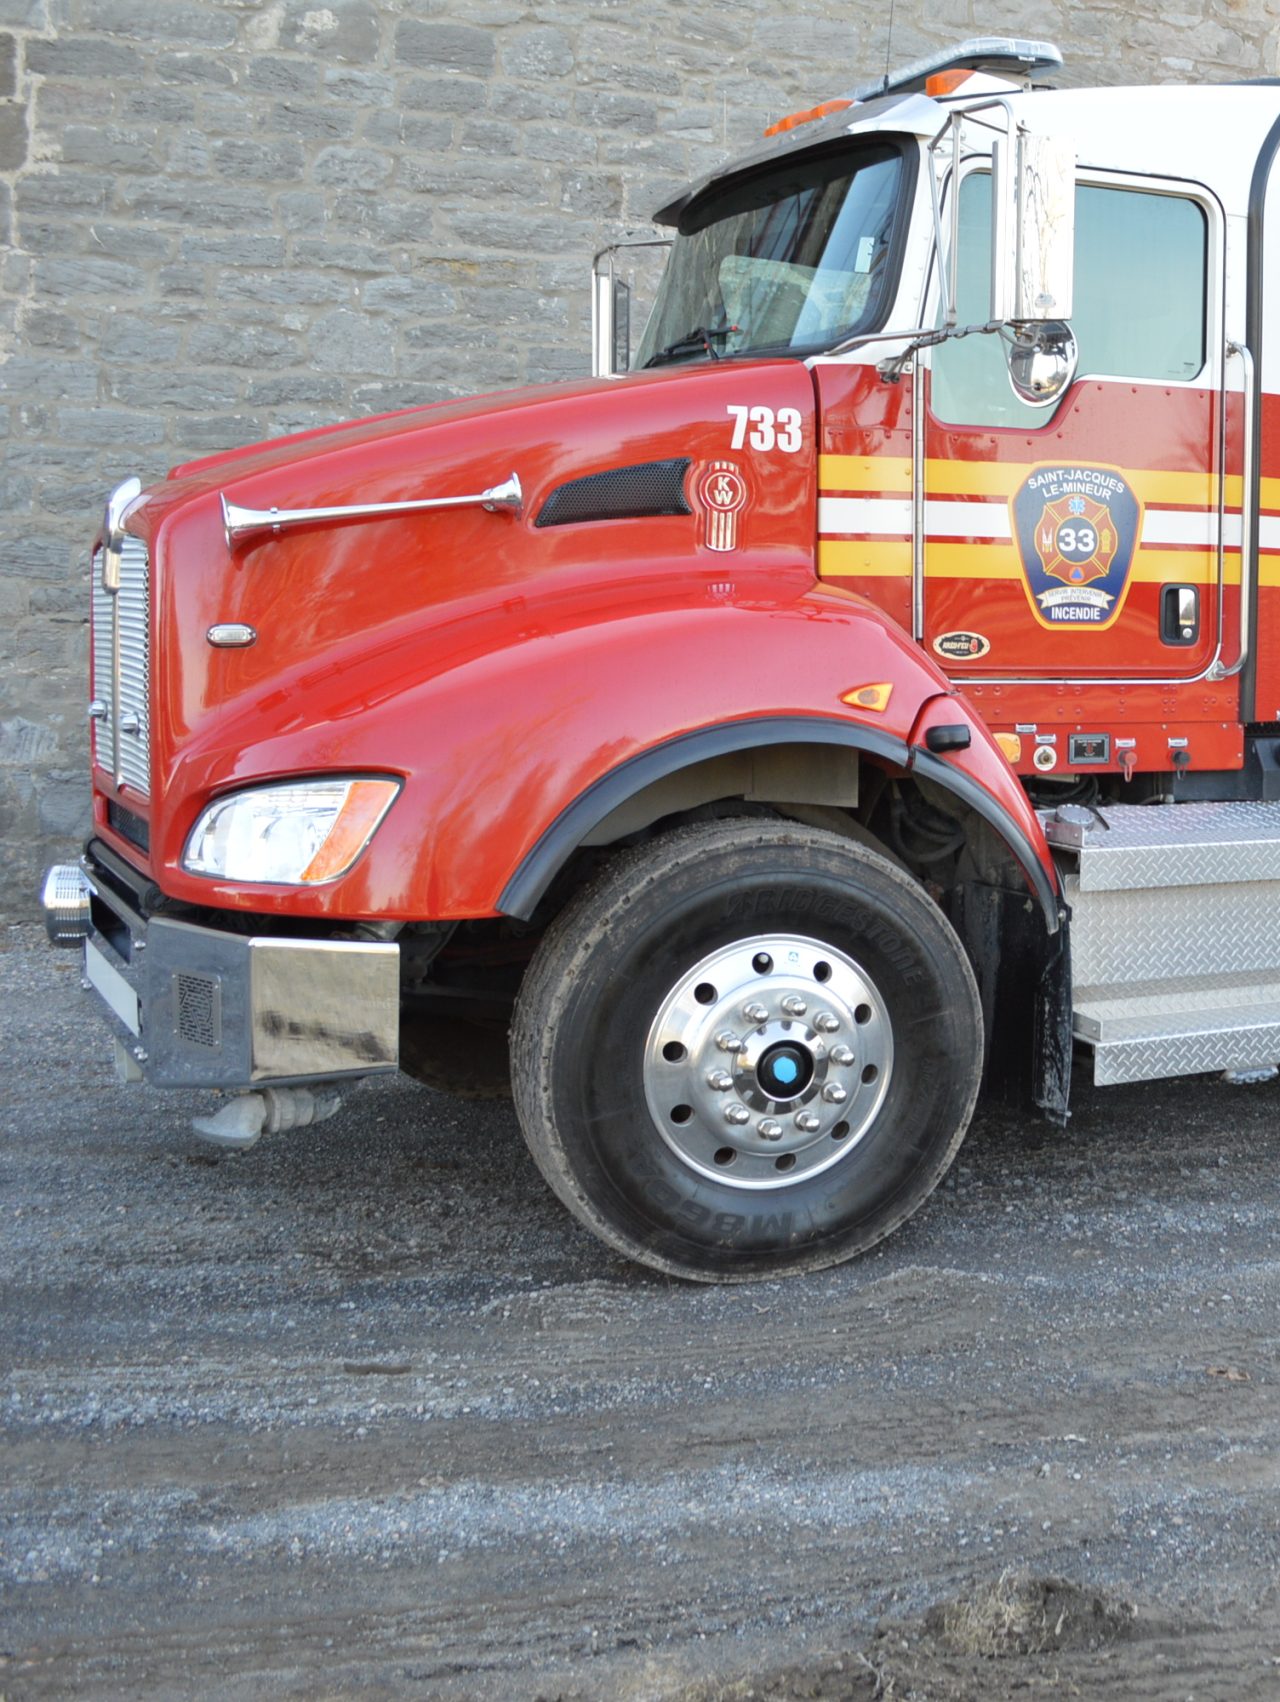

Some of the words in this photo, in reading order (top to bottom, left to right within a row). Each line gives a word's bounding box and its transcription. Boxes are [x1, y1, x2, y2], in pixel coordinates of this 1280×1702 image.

[727, 405, 803, 453] 733
[1028, 470, 1125, 493] SAINT-JACQUES
[1042, 482, 1112, 500] LE-MINEUR
[1058, 528, 1095, 552] 33
[1051, 607, 1101, 620] INCENDIE
